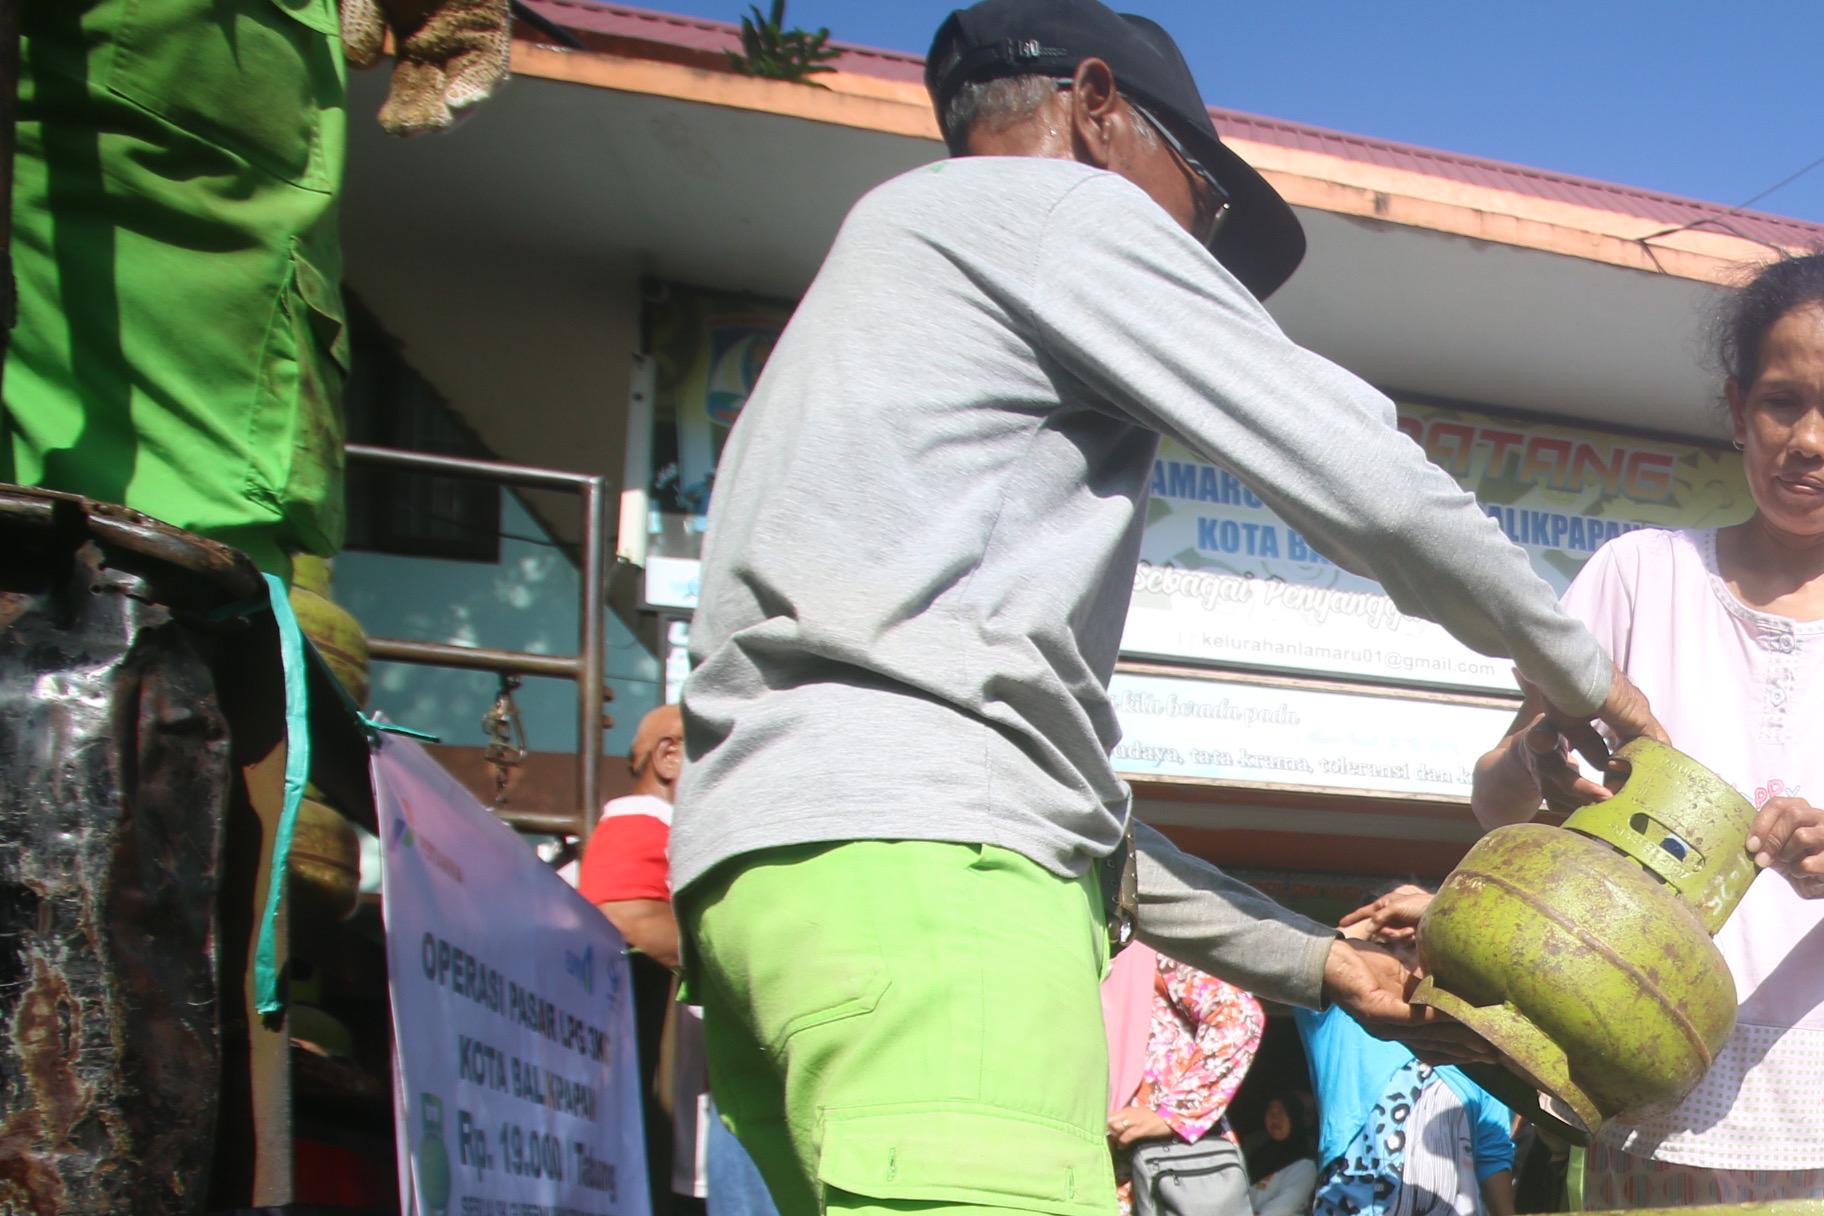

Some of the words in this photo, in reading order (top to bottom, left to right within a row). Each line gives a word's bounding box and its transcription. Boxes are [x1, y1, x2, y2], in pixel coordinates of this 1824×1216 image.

[1197, 517, 1279, 559] KOTA
[1262, 573, 1425, 632] Penyangg
[1202, 632, 1496, 677] kelurahanlamaru01@gmail.com
[1190, 748, 1234, 767] tata
[421, 931, 506, 1022] OPERASI
[508, 981, 558, 1042] PASAR
[458, 1034, 508, 1093] KOTA
[458, 1110, 494, 1182] Rp.
[501, 1122, 562, 1181] 19.000
